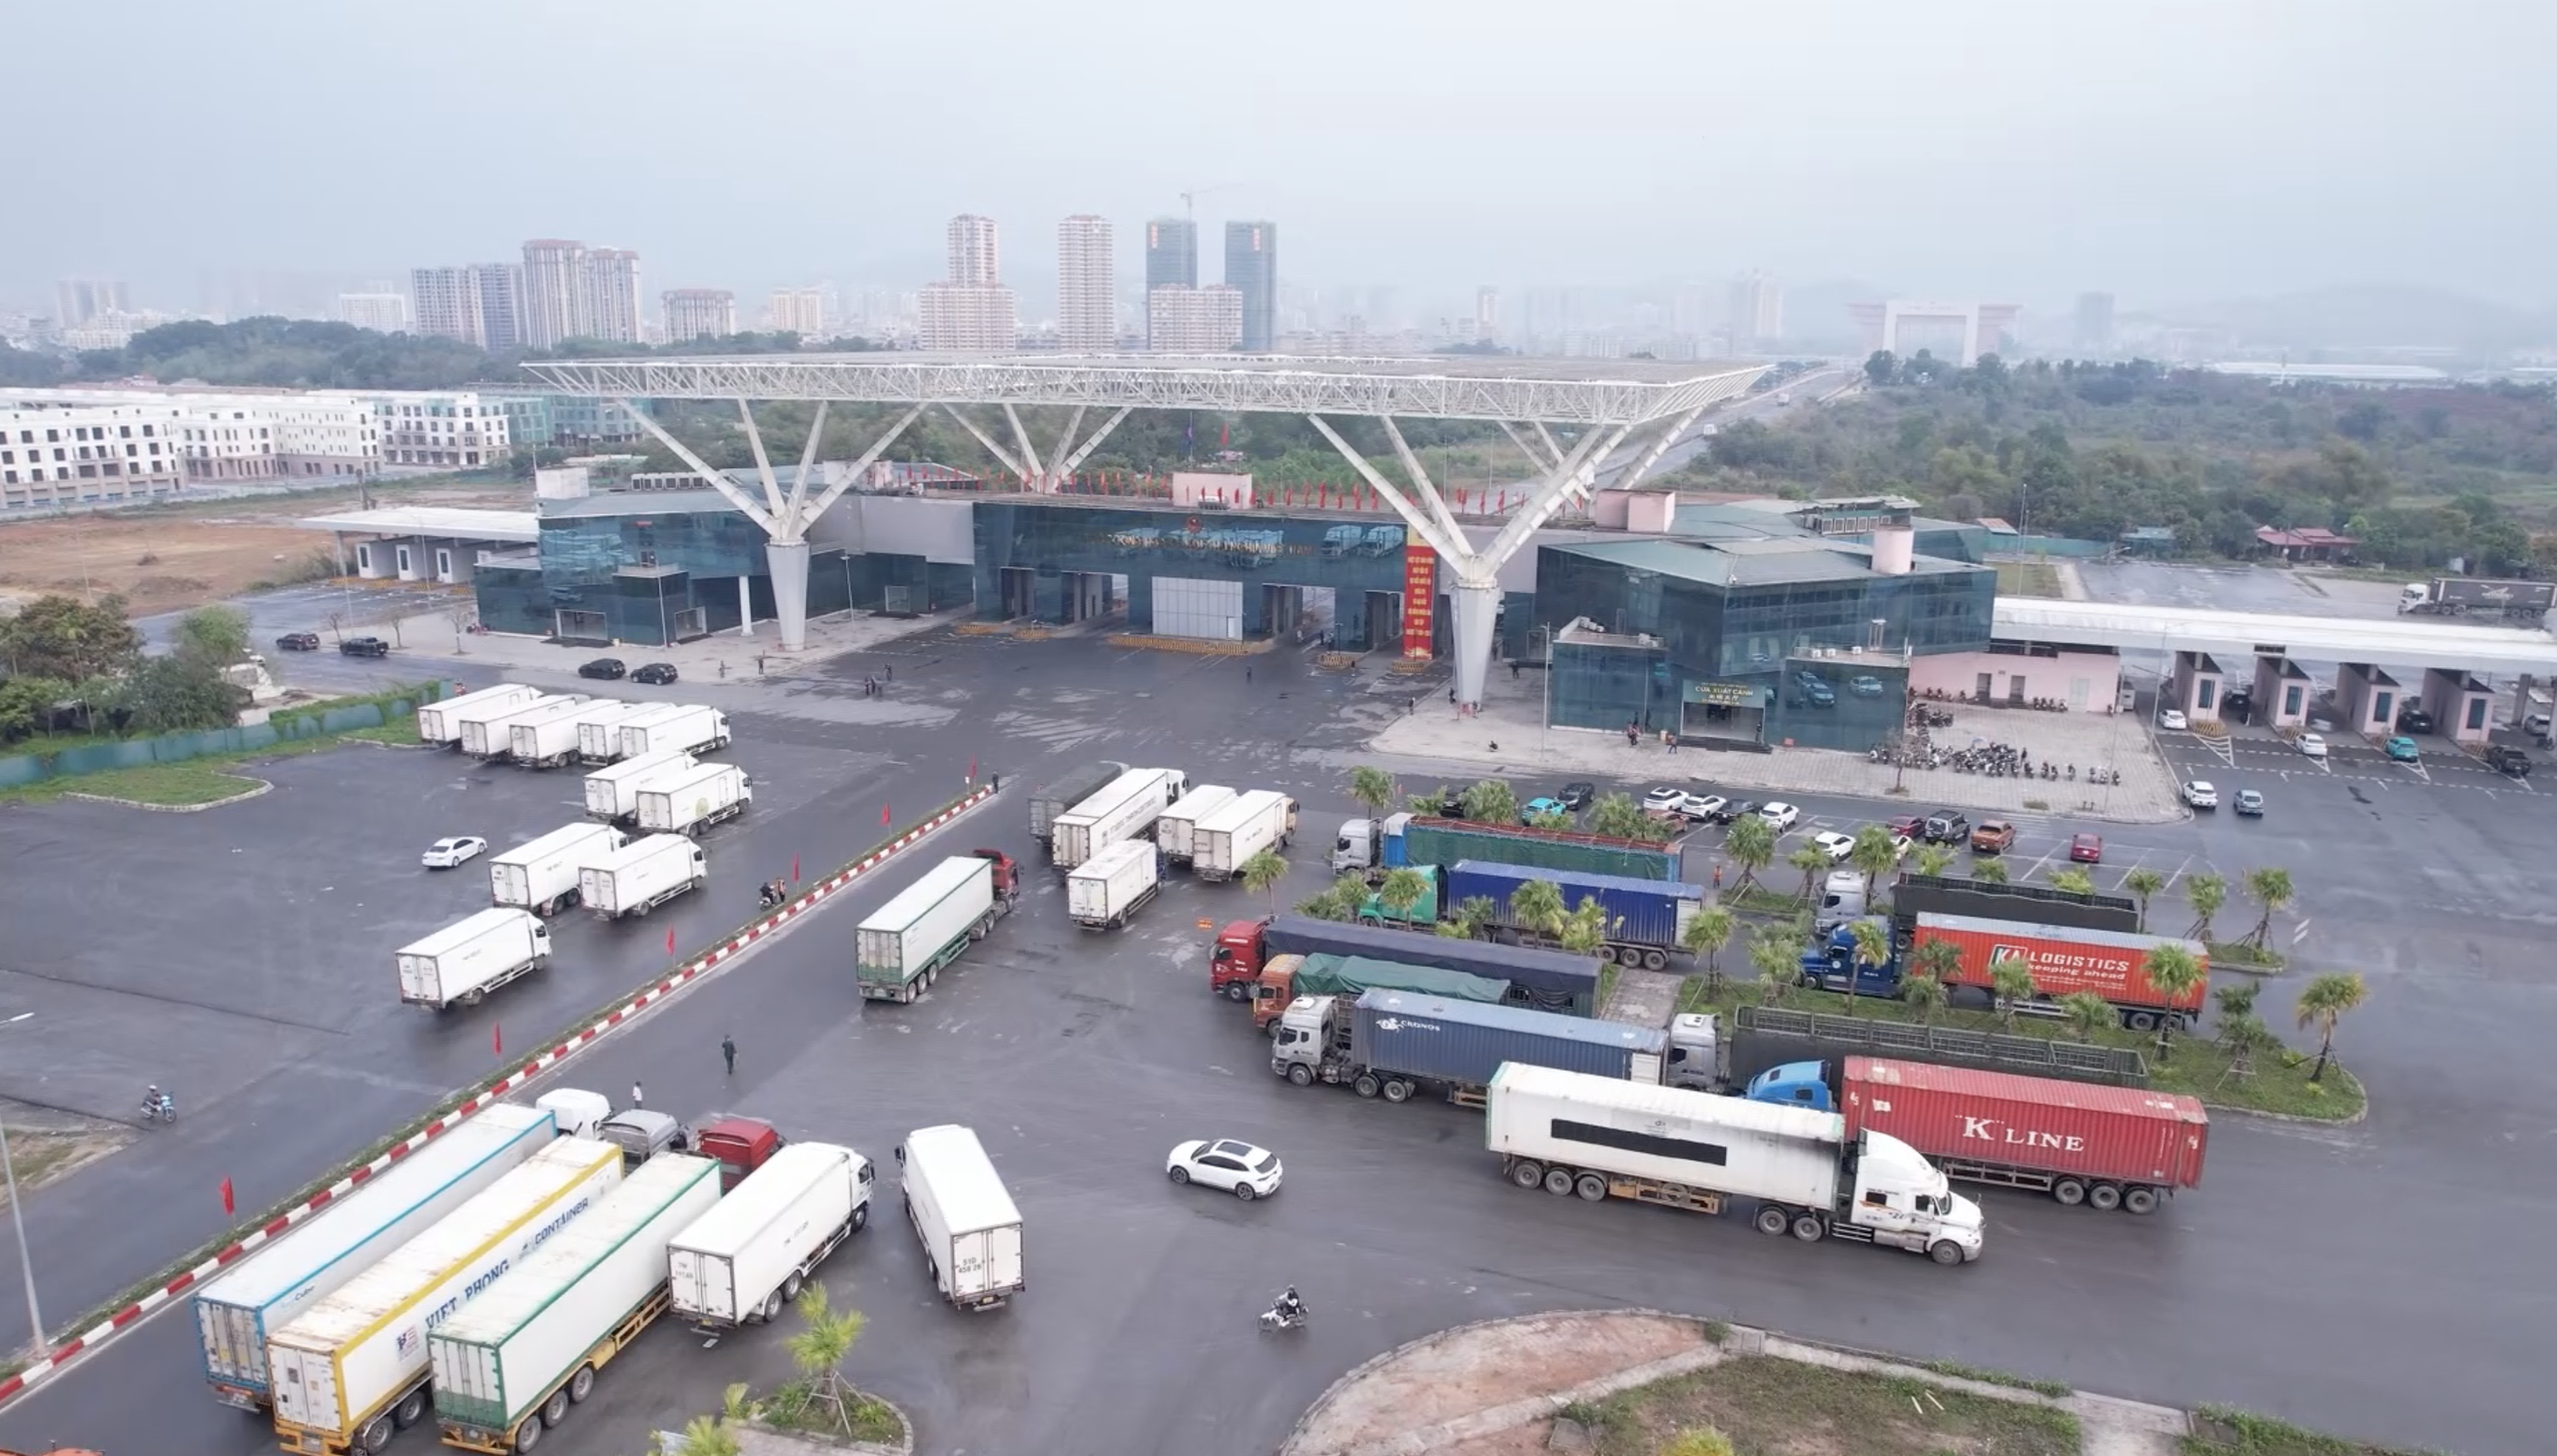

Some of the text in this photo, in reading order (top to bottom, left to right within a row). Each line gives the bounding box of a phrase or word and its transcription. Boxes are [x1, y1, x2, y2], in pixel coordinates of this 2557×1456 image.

[2029, 951, 2130, 973] LOGISTICS
[2084, 969, 2126, 980] ahead
[1400, 1020, 1441, 1032] CRONOS
[2006, 1128, 2085, 1151] LINE
[463, 1258, 510, 1300] PHONG
